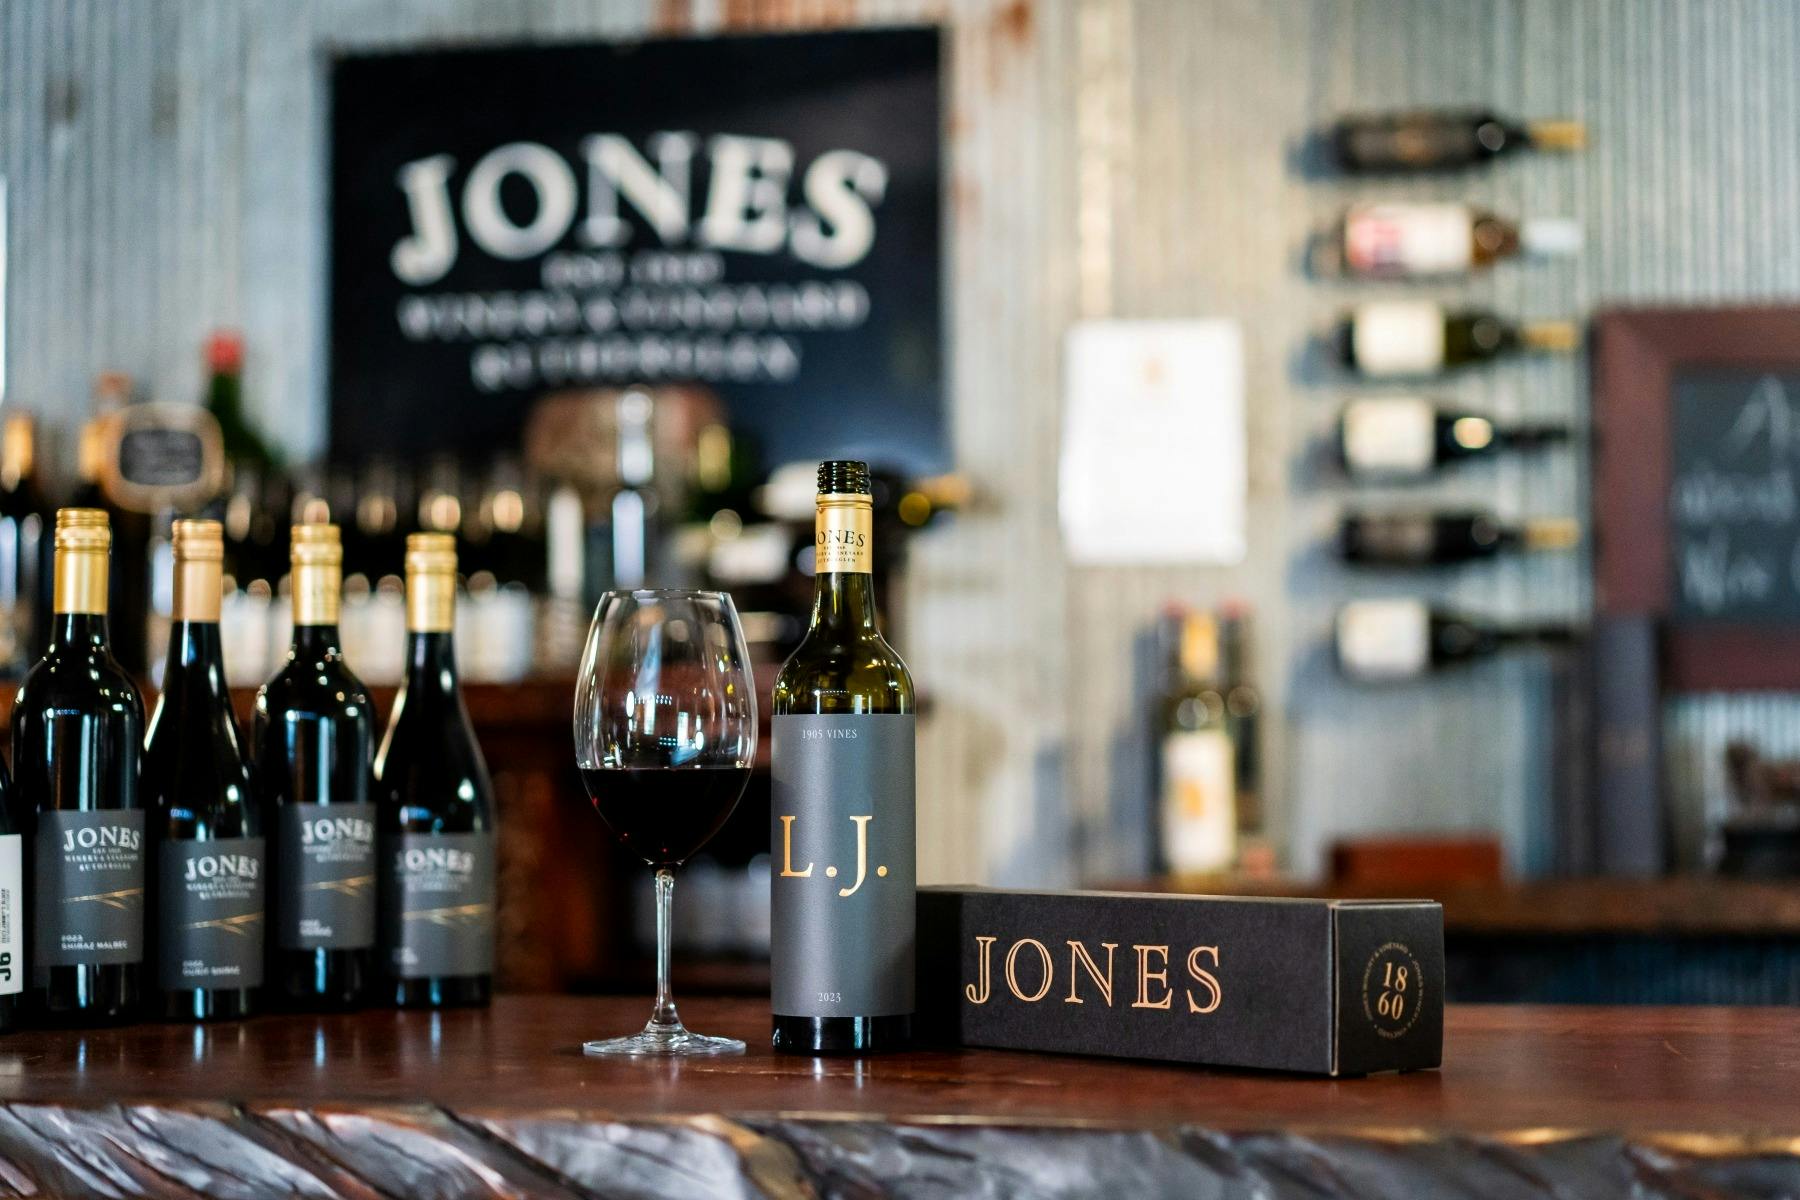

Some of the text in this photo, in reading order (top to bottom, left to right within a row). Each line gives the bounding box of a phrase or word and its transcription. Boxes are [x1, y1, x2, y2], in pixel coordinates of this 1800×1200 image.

[391, 131, 887, 285] JONES
[817, 530, 865, 547] ONES
[802, 729, 857, 739] 1905 VINES
[64, 825, 140, 852] JONES
[301, 818, 374, 844] JONES
[184, 854, 260, 881] JONES
[780, 816, 887, 897] L.J.
[97, 940, 128, 950] MALBEC
[965, 936, 1222, 1014] JONES
[1383, 962, 1408, 993] 18
[817, 992, 841, 1003] 2023
[1378, 991, 1404, 1020] 60
